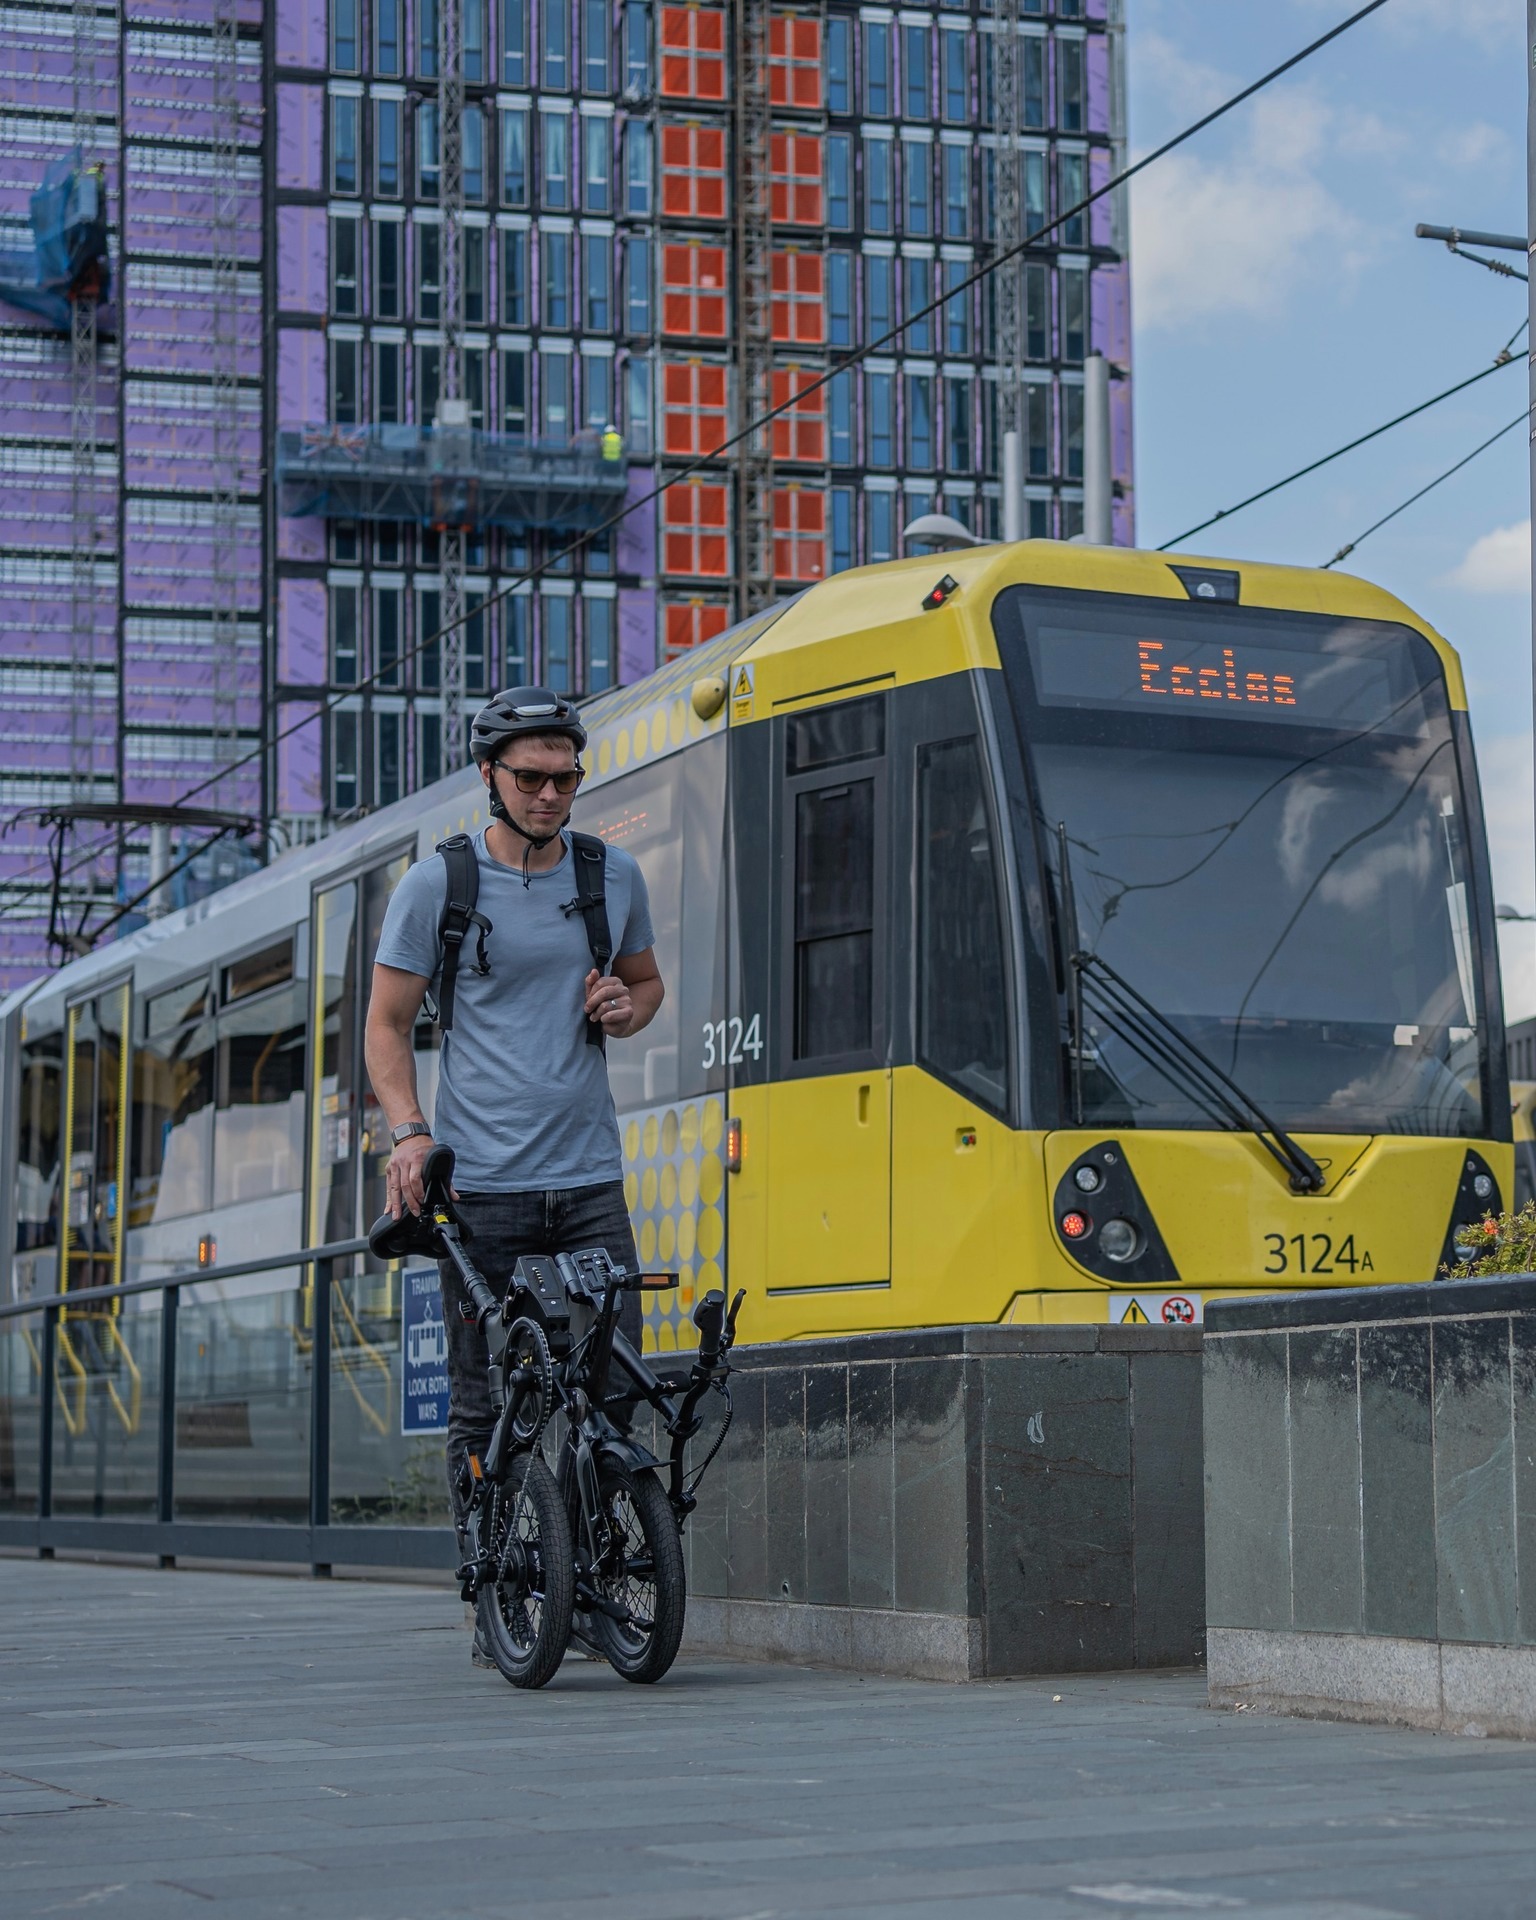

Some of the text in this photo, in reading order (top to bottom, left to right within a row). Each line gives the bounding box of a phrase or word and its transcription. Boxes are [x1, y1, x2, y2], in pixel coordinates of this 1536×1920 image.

[1138, 641, 1296, 705] Eccles
[701, 1013, 764, 1070] 3124
[1263, 1232, 1375, 1274] 3124A
[407, 1375, 449, 1397] LOOK BOTH
[417, 1402, 438, 1421] WAYS
